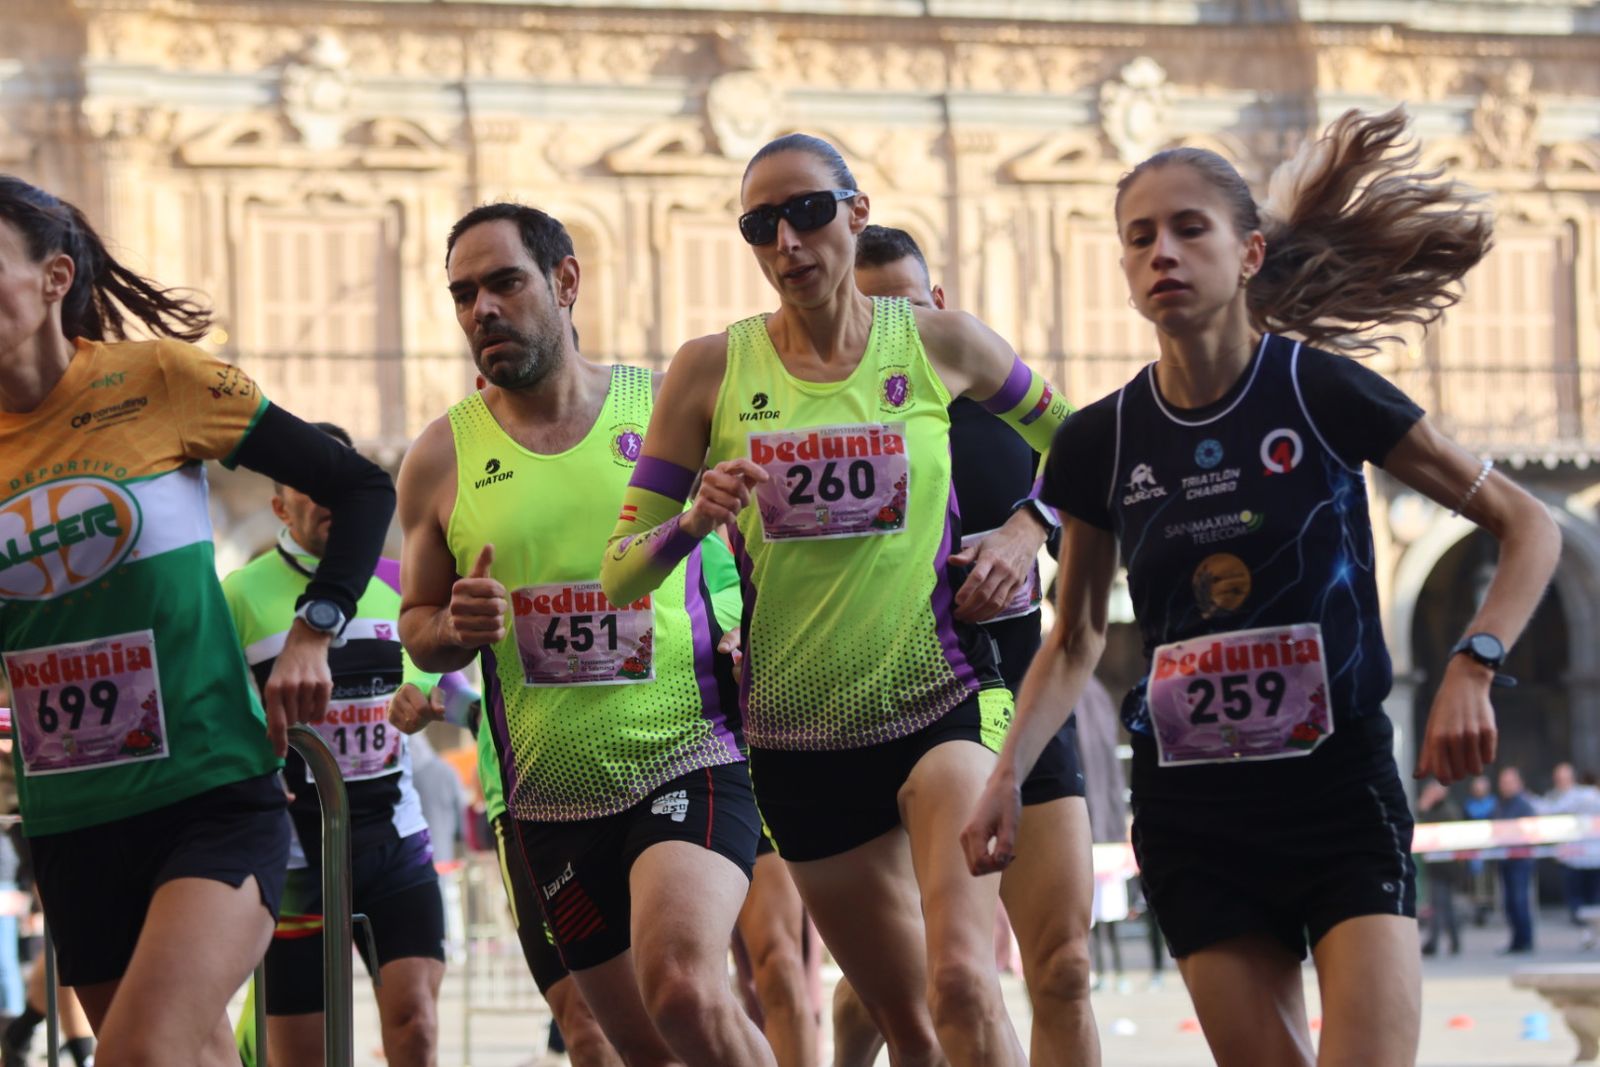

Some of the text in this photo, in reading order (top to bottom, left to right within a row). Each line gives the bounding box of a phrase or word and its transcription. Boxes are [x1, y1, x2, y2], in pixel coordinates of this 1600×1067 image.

[739, 410, 781, 422] VIATOR
[750, 429, 904, 465] bedunia
[9, 458, 128, 491] DEPORTIVO
[475, 470, 514, 489] VIATOR
[786, 459, 876, 506] 260
[543, 614, 618, 654] 451
[6, 642, 153, 689] bedunia
[38, 680, 119, 734] 699
[1187, 671, 1286, 726] 259
[333, 723, 386, 755] 118
